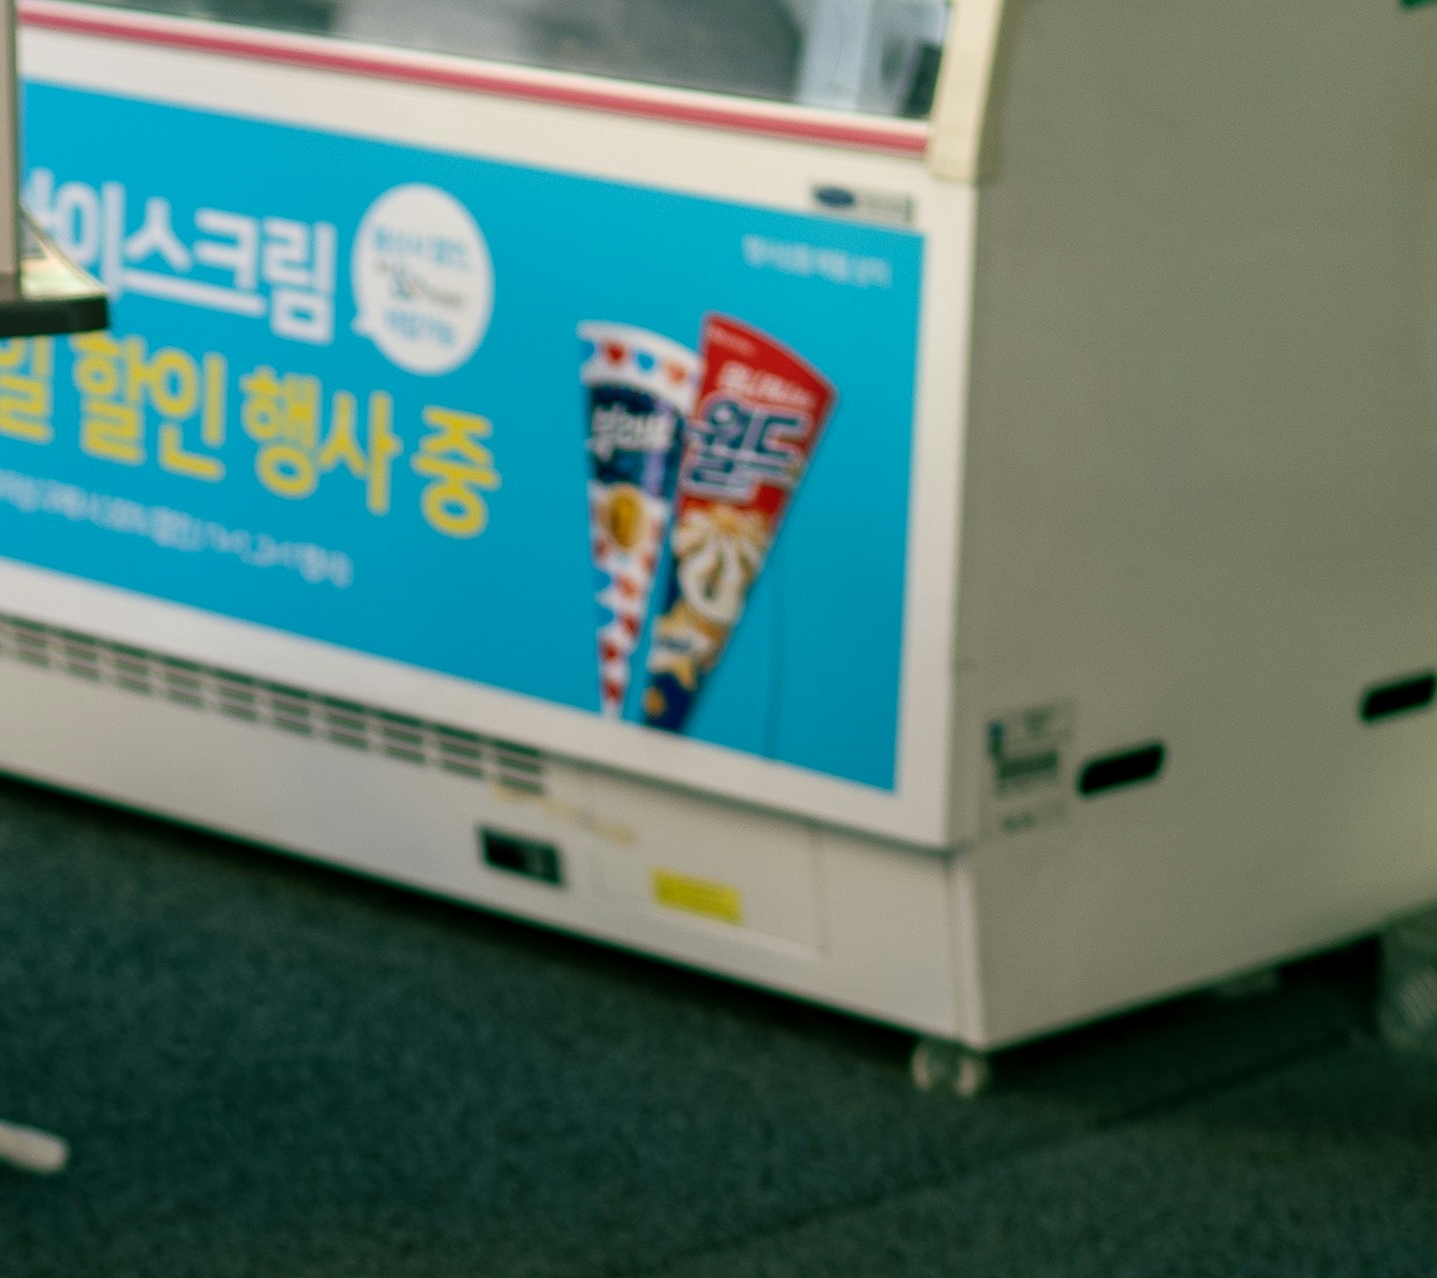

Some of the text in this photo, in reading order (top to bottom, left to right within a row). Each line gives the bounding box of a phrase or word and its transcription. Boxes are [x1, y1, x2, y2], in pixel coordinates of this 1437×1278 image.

[28, 168, 336, 344] 이스크림
[69, 334, 228, 482] 할인
[239, 364, 404, 517] 행사
[410, 404, 503, 540] 중
